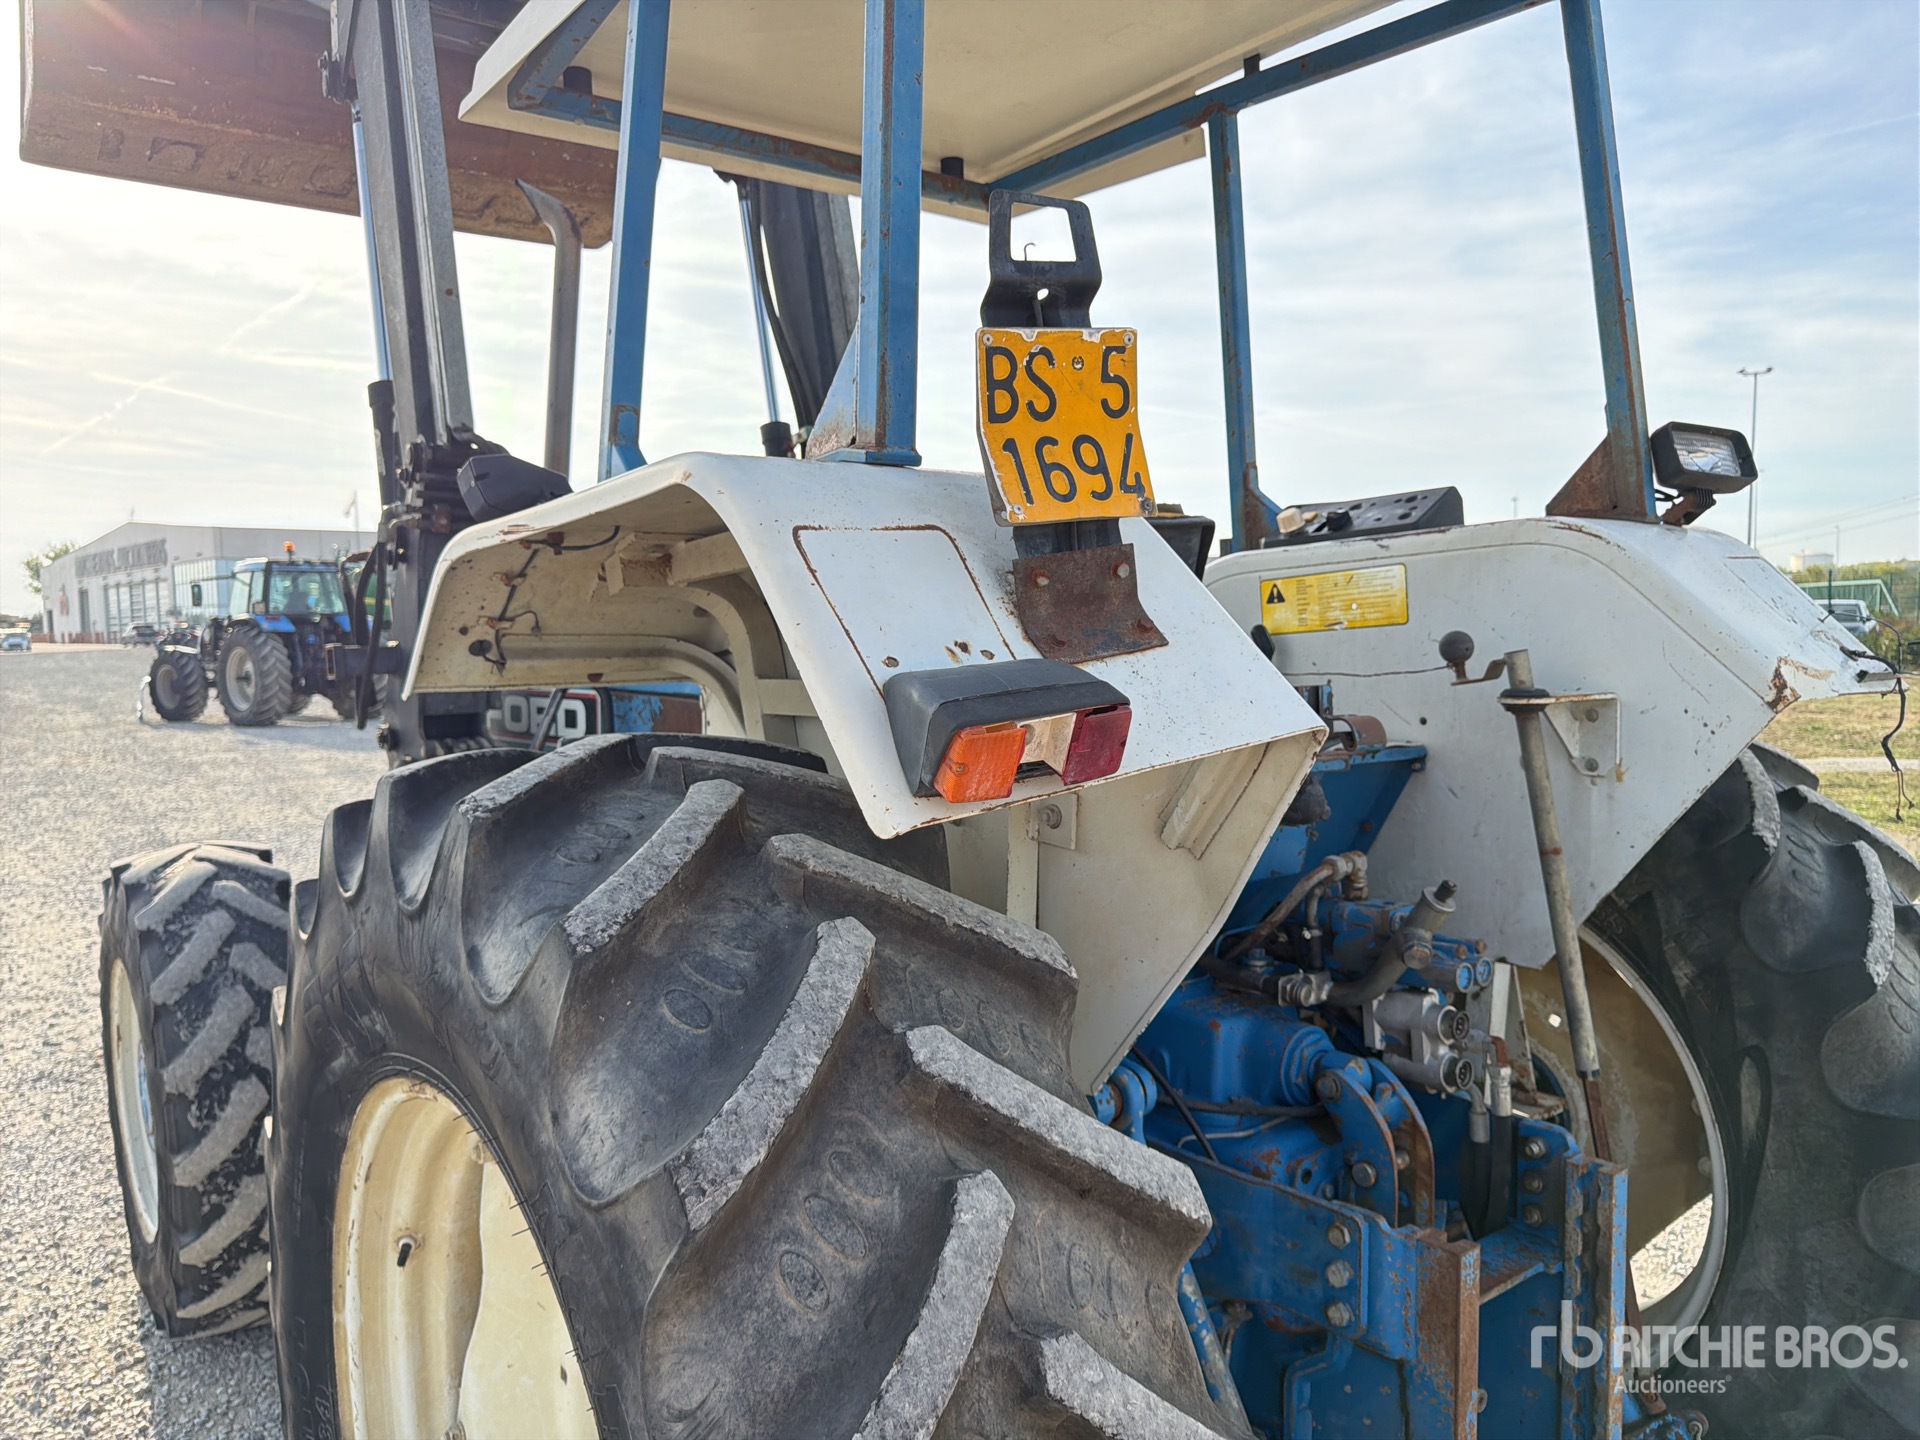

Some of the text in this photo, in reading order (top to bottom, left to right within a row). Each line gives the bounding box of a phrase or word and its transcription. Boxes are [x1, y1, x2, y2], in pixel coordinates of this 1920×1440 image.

[985, 345, 1130, 424] BS 5
[1002, 433, 1146, 506] 1694
